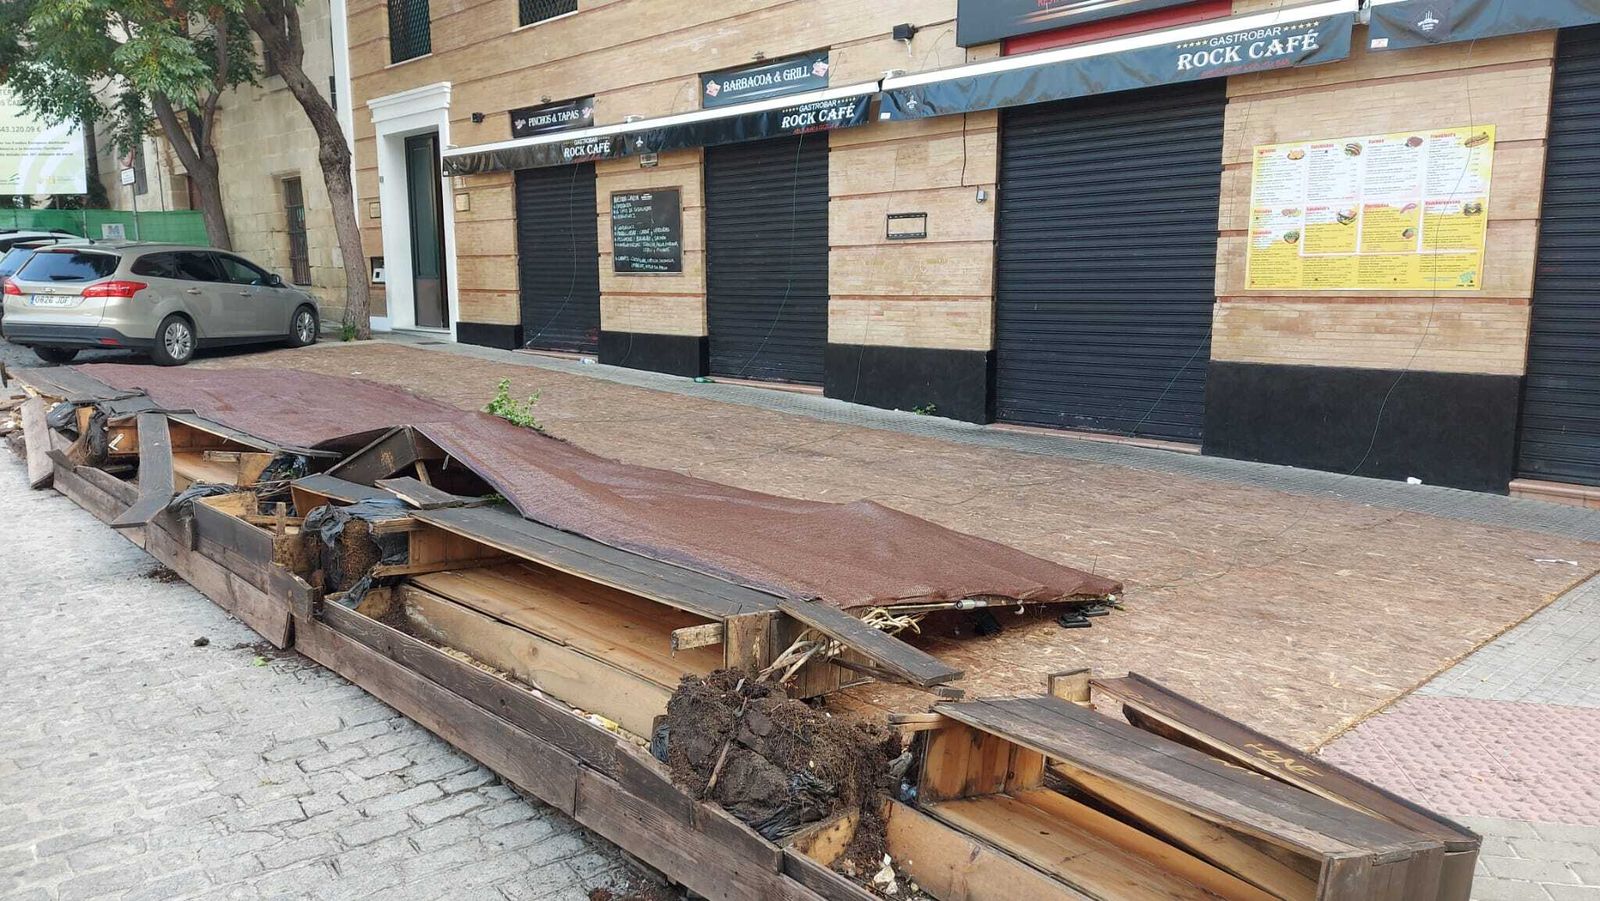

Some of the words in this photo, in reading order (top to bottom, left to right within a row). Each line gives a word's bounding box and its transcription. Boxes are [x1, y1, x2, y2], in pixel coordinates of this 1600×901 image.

[1209, 26, 1282, 47] GASTROBAR
[1177, 45, 1242, 71] ROCK
[1249, 29, 1320, 59] CAFÉ
[723, 73, 773, 93] BARBACOA
[773, 71, 782, 83] &
[783, 66, 811, 80] GRILL
[781, 112, 815, 129] ROCK
[818, 101, 856, 122] CAFÉ
[799, 99, 837, 113] GASTROBAR
[528, 115, 551, 127] PINCHOS
[551, 113, 557, 122] &
[558, 110, 579, 122] TAPAS
[564, 145, 586, 158] ROCK
[587, 140, 610, 153] CAFÉ
